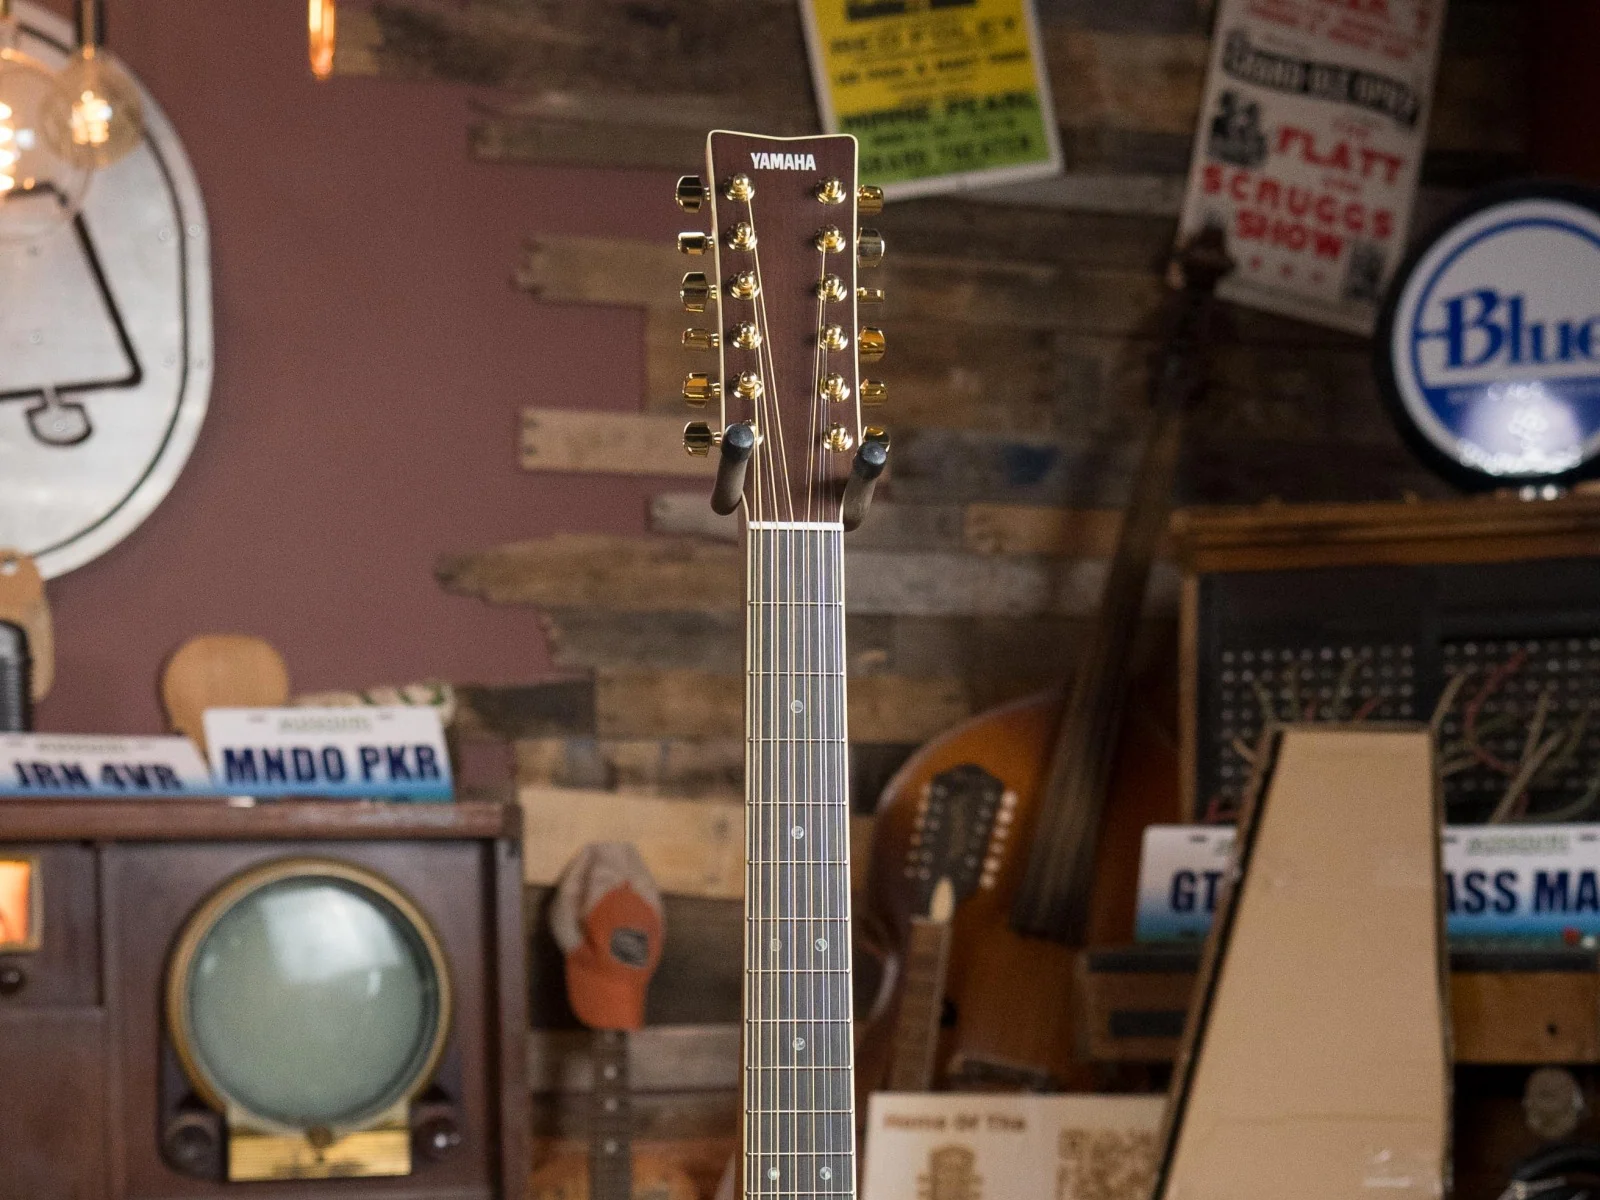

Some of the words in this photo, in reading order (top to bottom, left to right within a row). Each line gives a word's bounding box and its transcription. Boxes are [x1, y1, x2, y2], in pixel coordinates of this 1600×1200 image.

[750, 152, 816, 171] YAMAHA
[1440, 288, 1600, 369] Blue
[223, 746, 346, 783] MNDO
[359, 744, 440, 782] PKR
